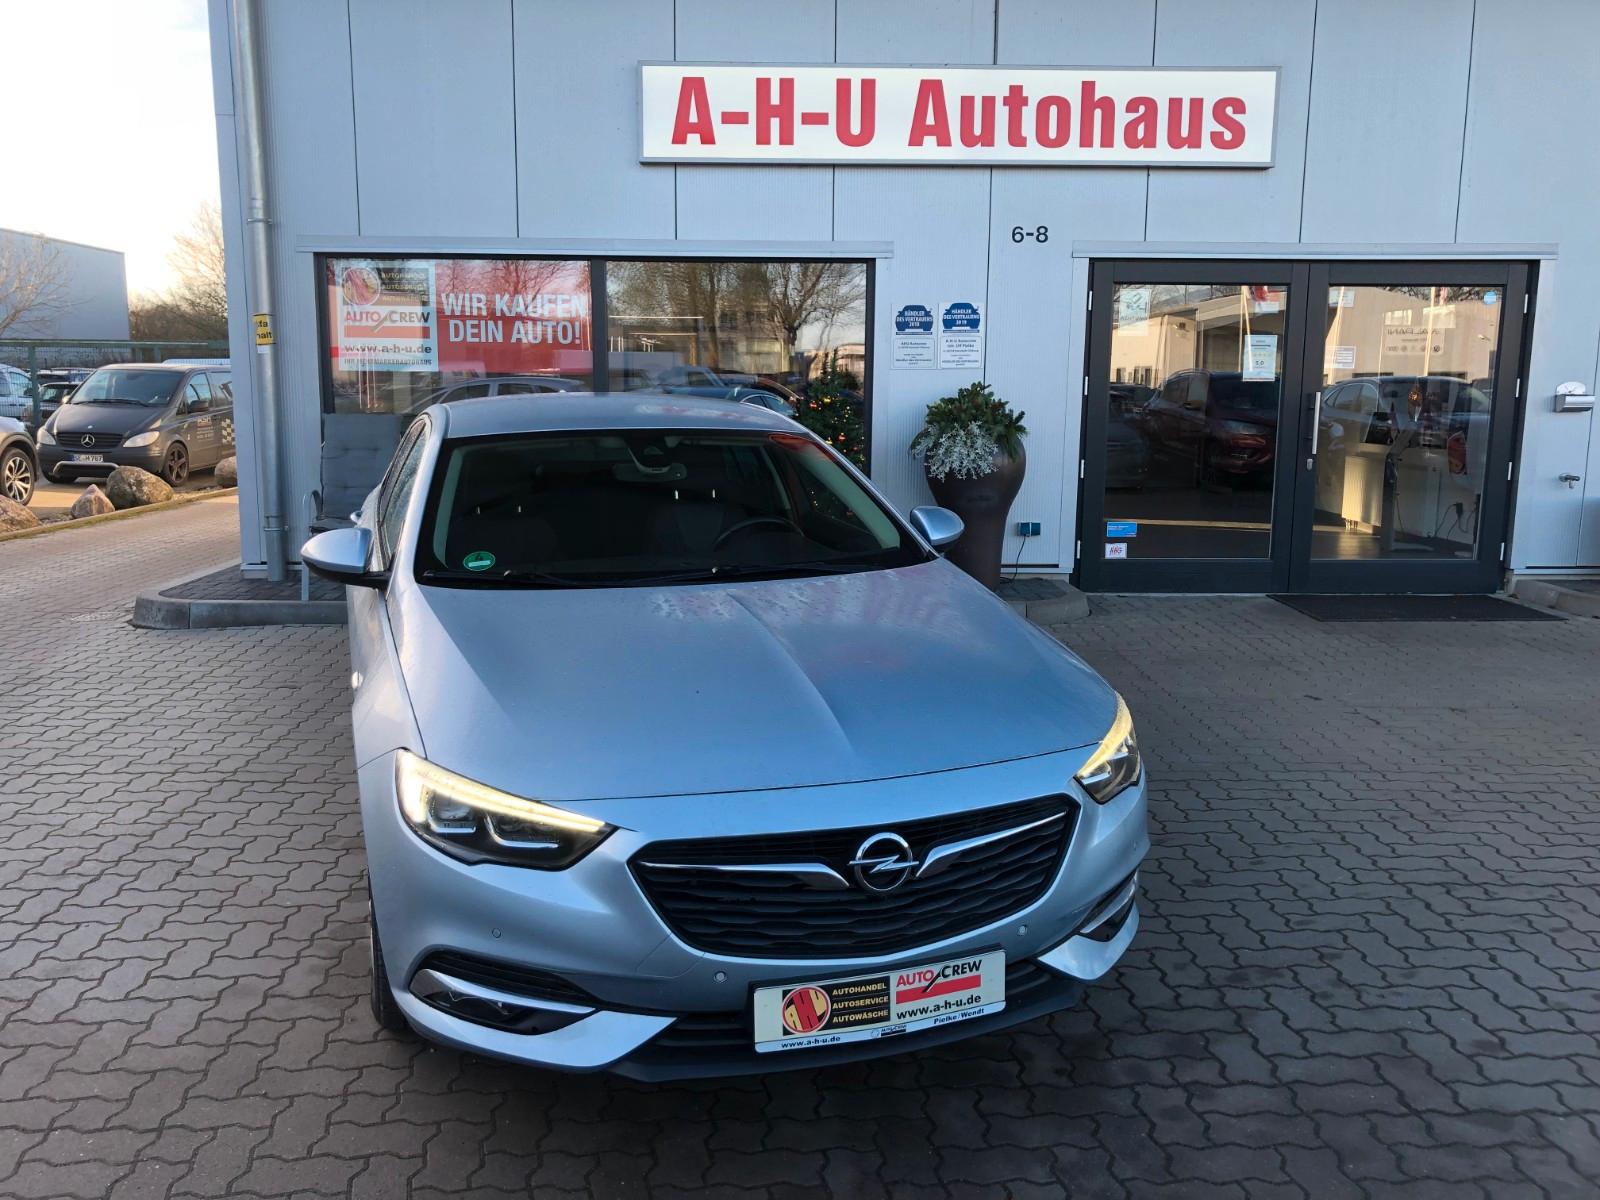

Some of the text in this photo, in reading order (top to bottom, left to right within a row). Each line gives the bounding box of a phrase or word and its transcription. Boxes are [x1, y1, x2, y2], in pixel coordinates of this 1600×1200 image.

[671, 76, 1247, 150] A-H-U Autohaus
[1011, 225, 1049, 243] 6-8
[441, 292, 588, 318] WIR KAUFEN
[449, 319, 581, 345] DEIN AUTO!
[832, 982, 887, 996] AUTOHANDEL
[832, 995, 889, 1010] AUTOSERVICE
[896, 994, 982, 1020] www.a-h-u.de
[832, 1008, 889, 1023] AUTOWÄSCHE
[781, 1036, 841, 1048] www.a-h-u.de
